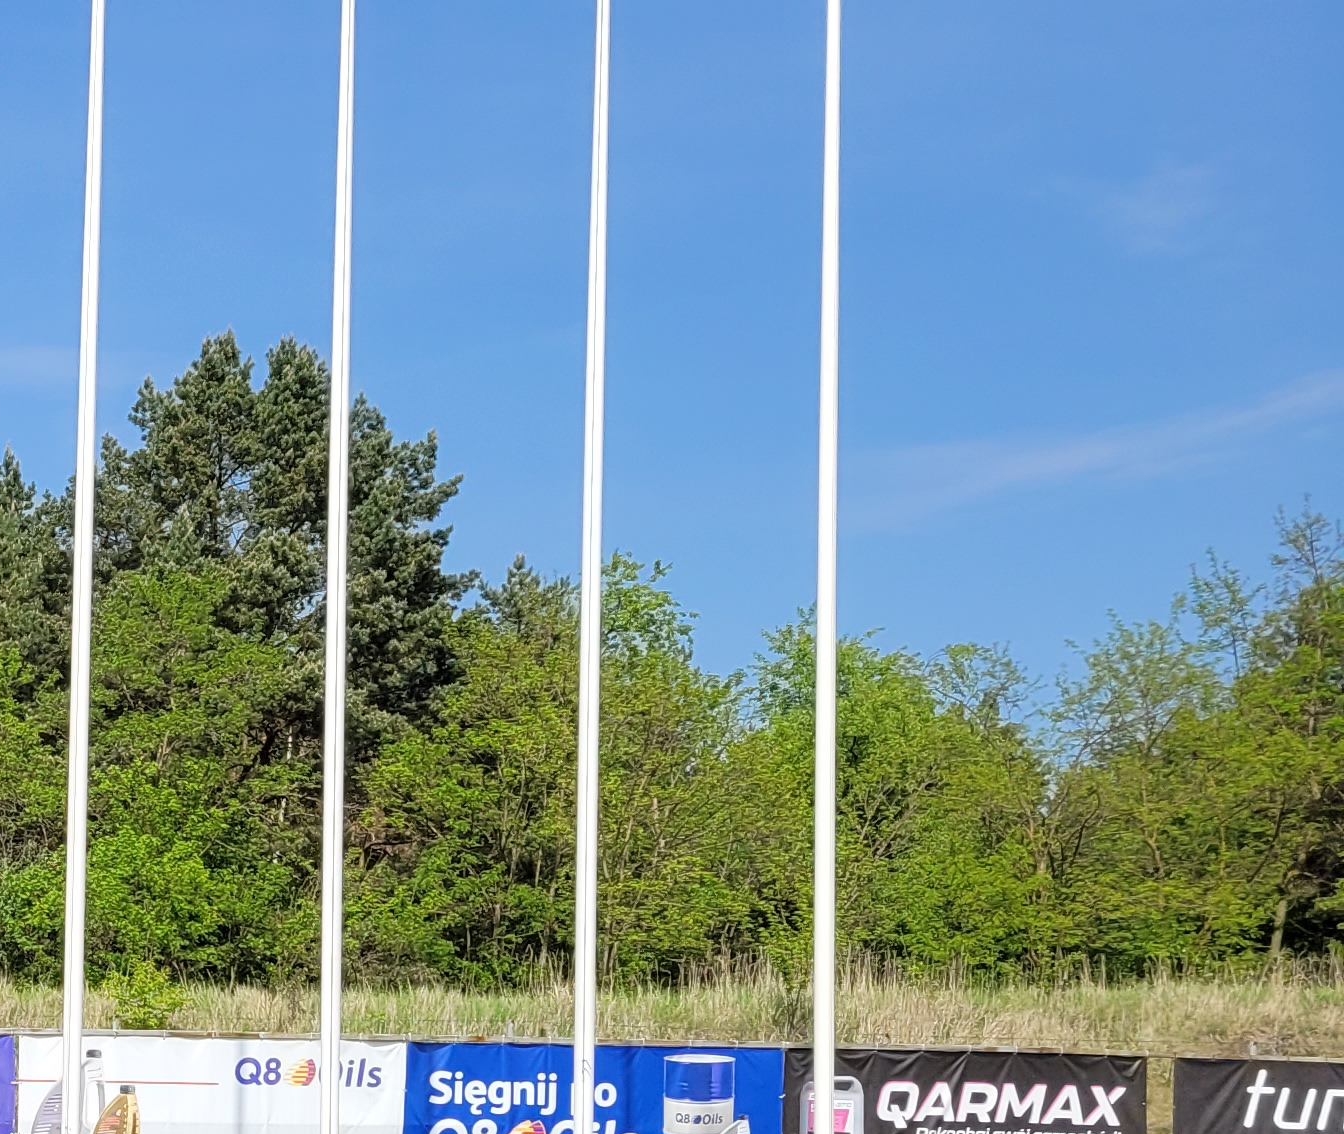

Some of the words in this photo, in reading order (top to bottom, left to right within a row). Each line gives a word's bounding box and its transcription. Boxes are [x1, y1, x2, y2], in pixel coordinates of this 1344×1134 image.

[234, 1057, 282, 1086] Q8
[318, 1058, 383, 1088] ils
[429, 1070, 558, 1115] Sięgnij
[876, 1080, 1127, 1129] QARMAX
